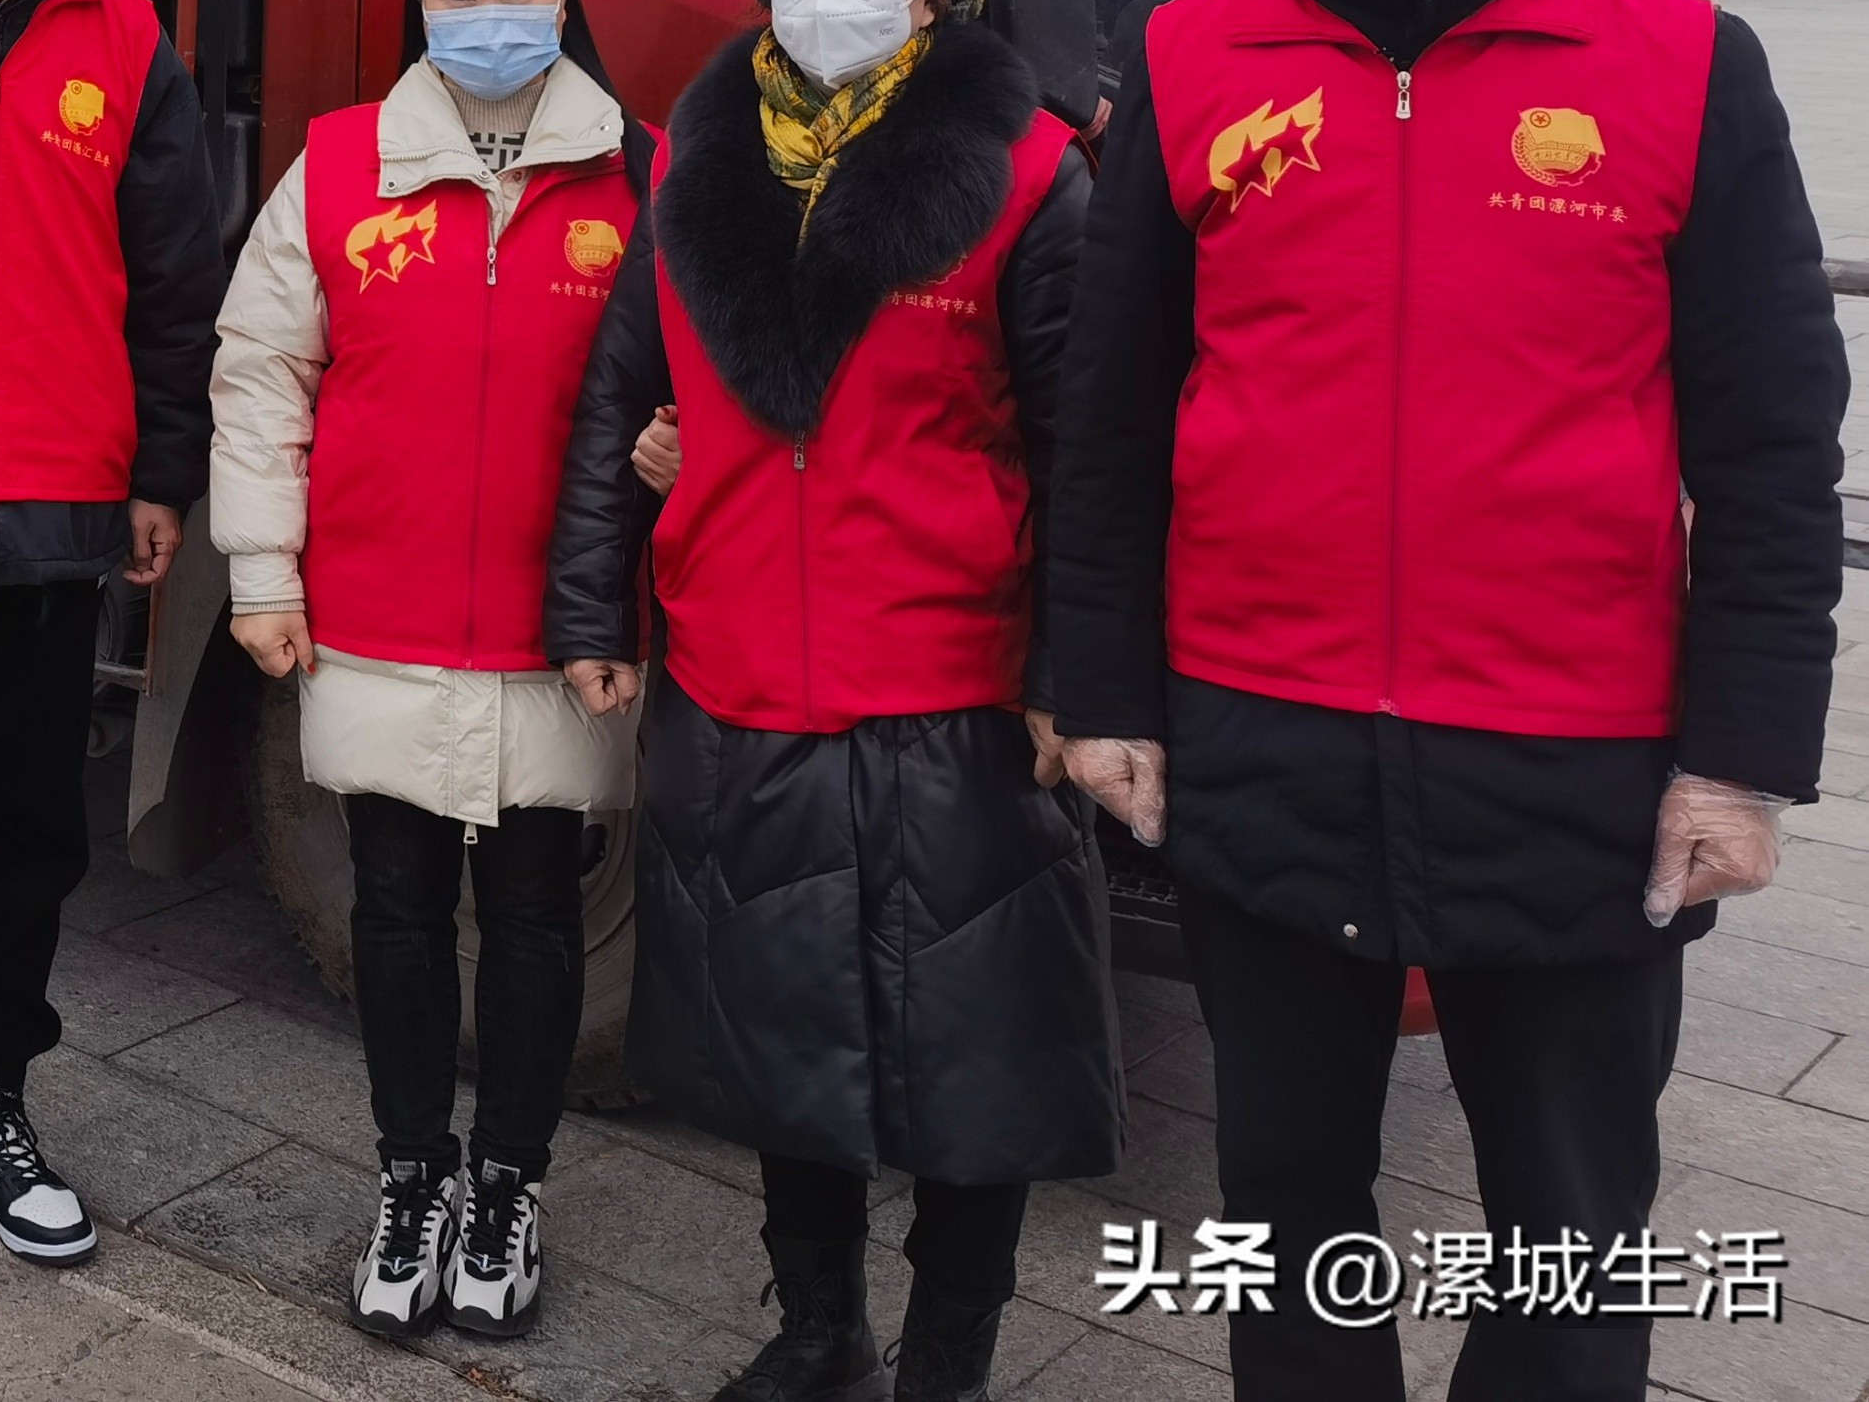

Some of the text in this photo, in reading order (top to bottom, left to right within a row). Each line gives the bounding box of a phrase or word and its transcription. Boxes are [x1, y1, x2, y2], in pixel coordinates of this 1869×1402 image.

[1486, 191, 1628, 224] 共青团漯河市委
[882, 290, 978, 315] 青团漯河市委
